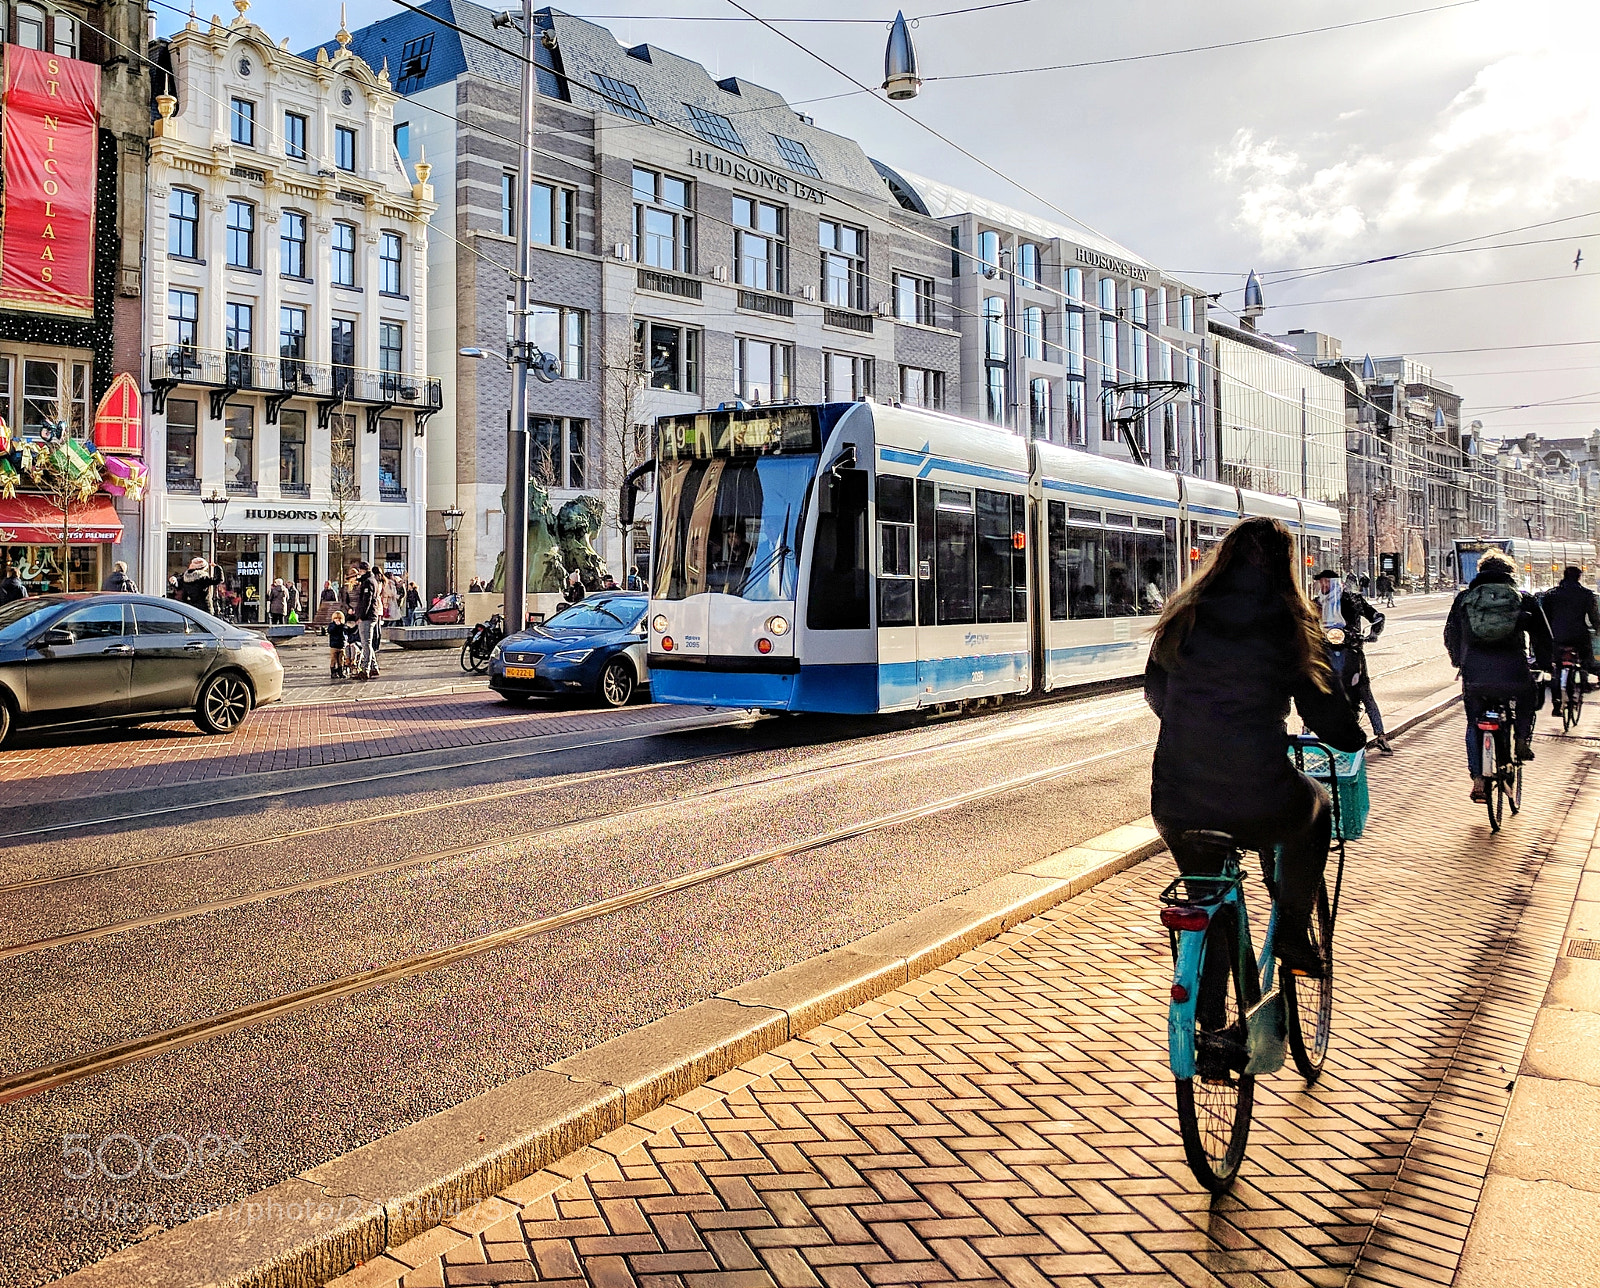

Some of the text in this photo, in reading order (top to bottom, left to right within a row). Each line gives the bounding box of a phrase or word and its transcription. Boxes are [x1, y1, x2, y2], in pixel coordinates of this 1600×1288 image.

[40, 59, 60, 284] ST NICOLAAS
[687, 148, 827, 205] HUDSON'S BAY
[1076, 247, 1150, 282] HUDSON'S BAY
[245, 509, 318, 520] HUDSON'S
[237, 561, 263, 569] BLACK
[383, 561, 405, 569] BLACK
[237, 568, 263, 576] FRIDAY
